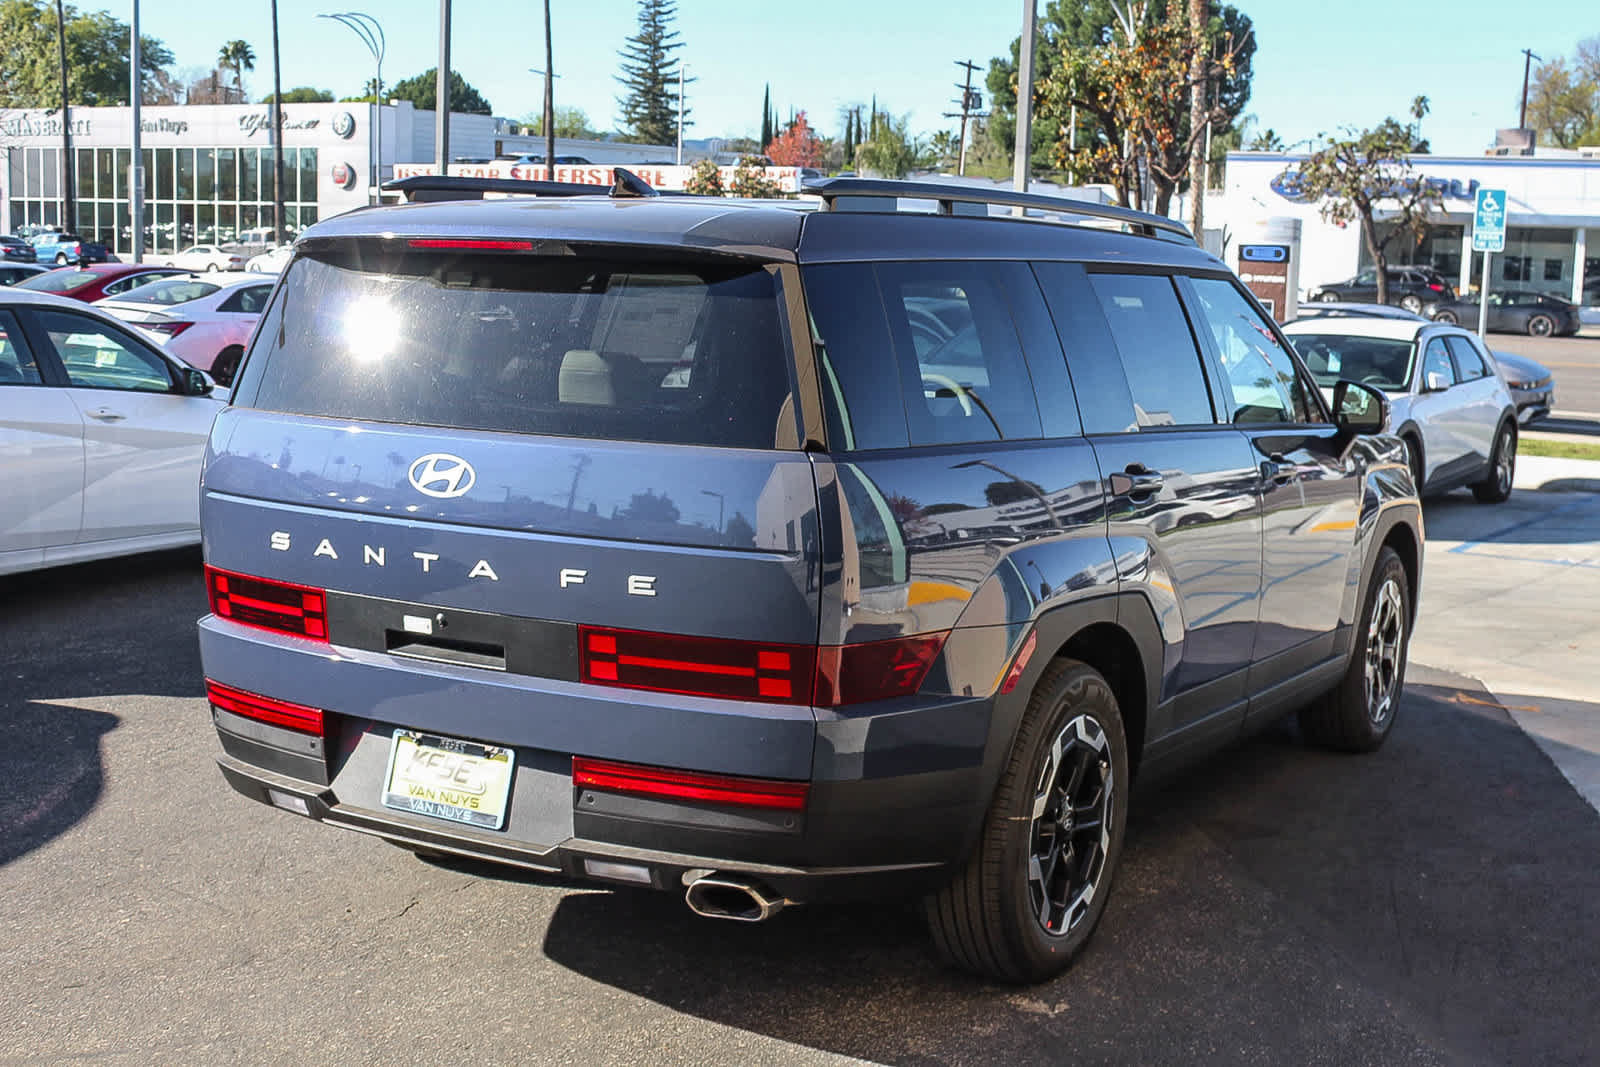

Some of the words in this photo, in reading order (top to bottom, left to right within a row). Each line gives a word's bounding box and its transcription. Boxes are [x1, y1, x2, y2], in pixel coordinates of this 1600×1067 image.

[510, 167, 667, 187] SUERSTRE
[270, 531, 499, 582] SANTA
[559, 568, 657, 597] FE
[409, 783, 436, 800] VAN
[438, 790, 481, 809] NUYS
[408, 797, 437, 814] VAN
[437, 803, 473, 821] NUYS
